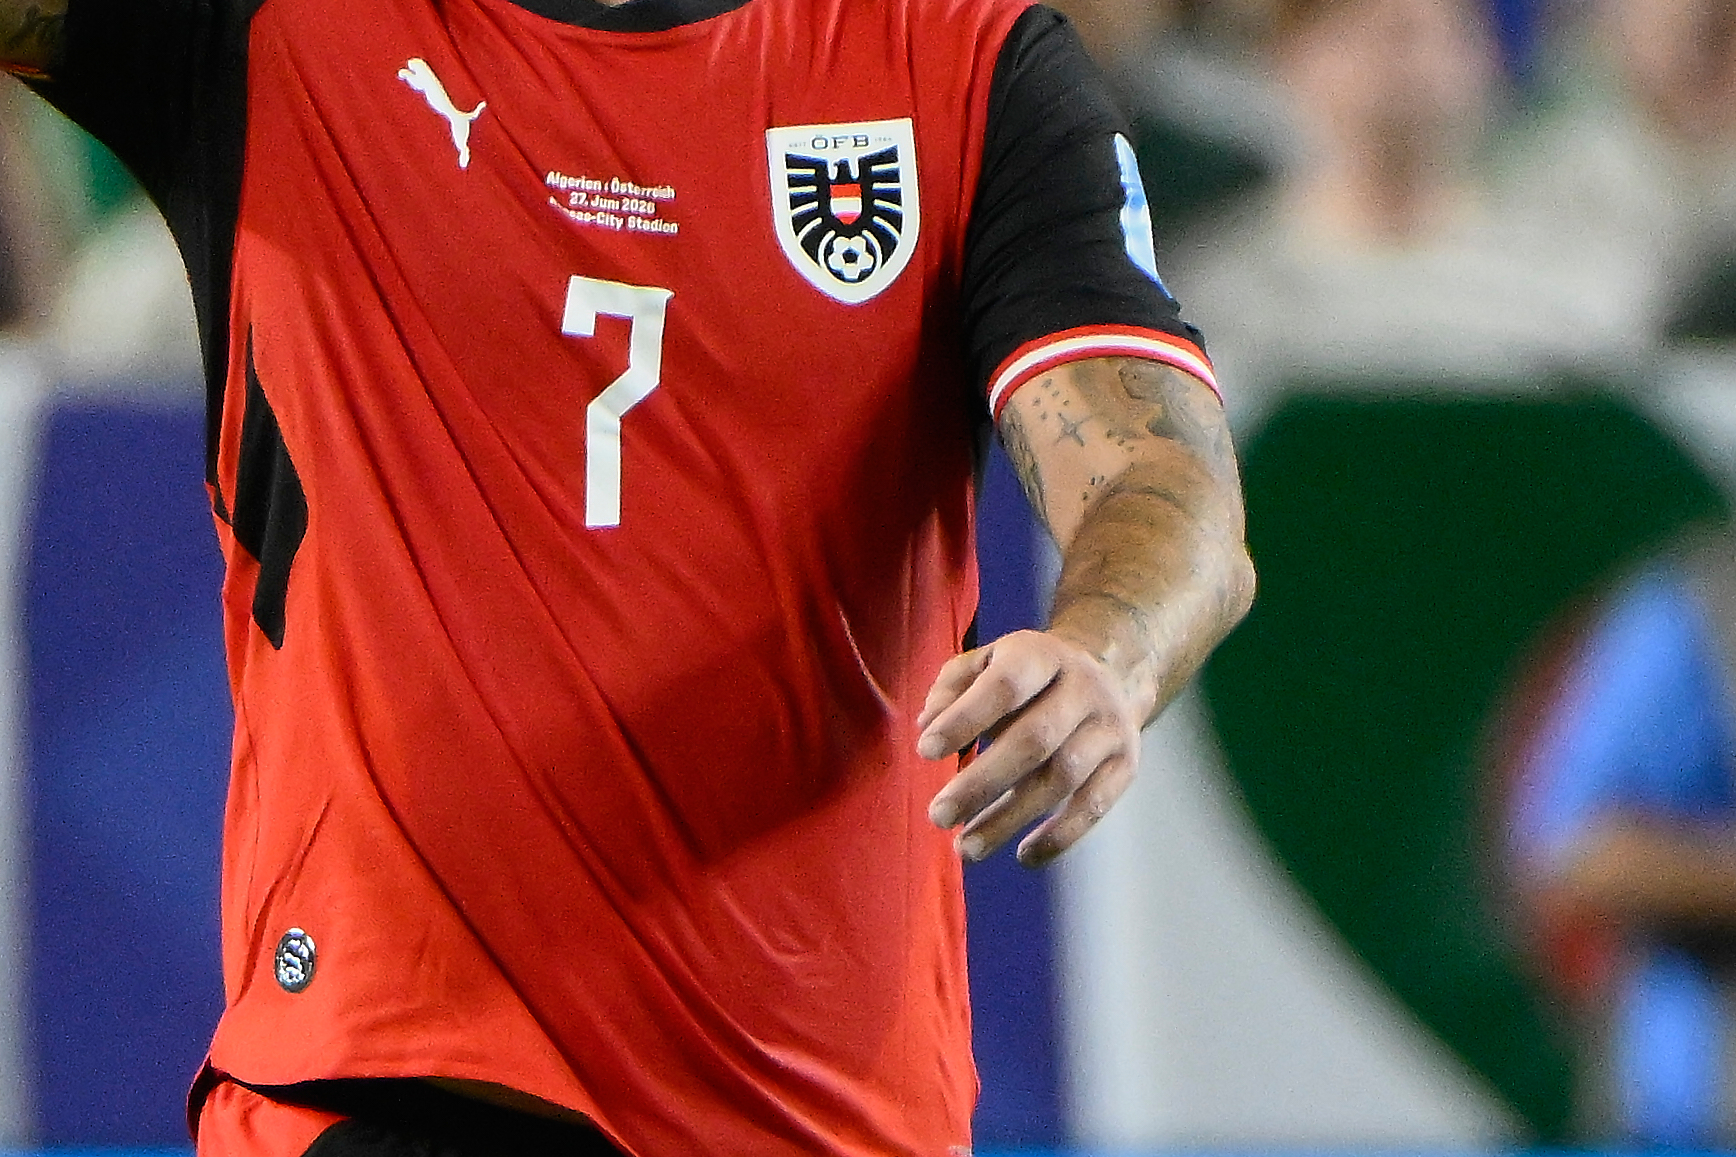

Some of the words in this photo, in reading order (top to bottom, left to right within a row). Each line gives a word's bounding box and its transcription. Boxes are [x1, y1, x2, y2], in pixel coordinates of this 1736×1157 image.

[811, 134, 869, 150] ÖFB
[546, 170, 602, 191] Algerien
[610, 176, 676, 200] Österreich
[590, 194, 620, 210] Juni
[627, 215, 679, 234] Stadion
[561, 274, 675, 527] 7
